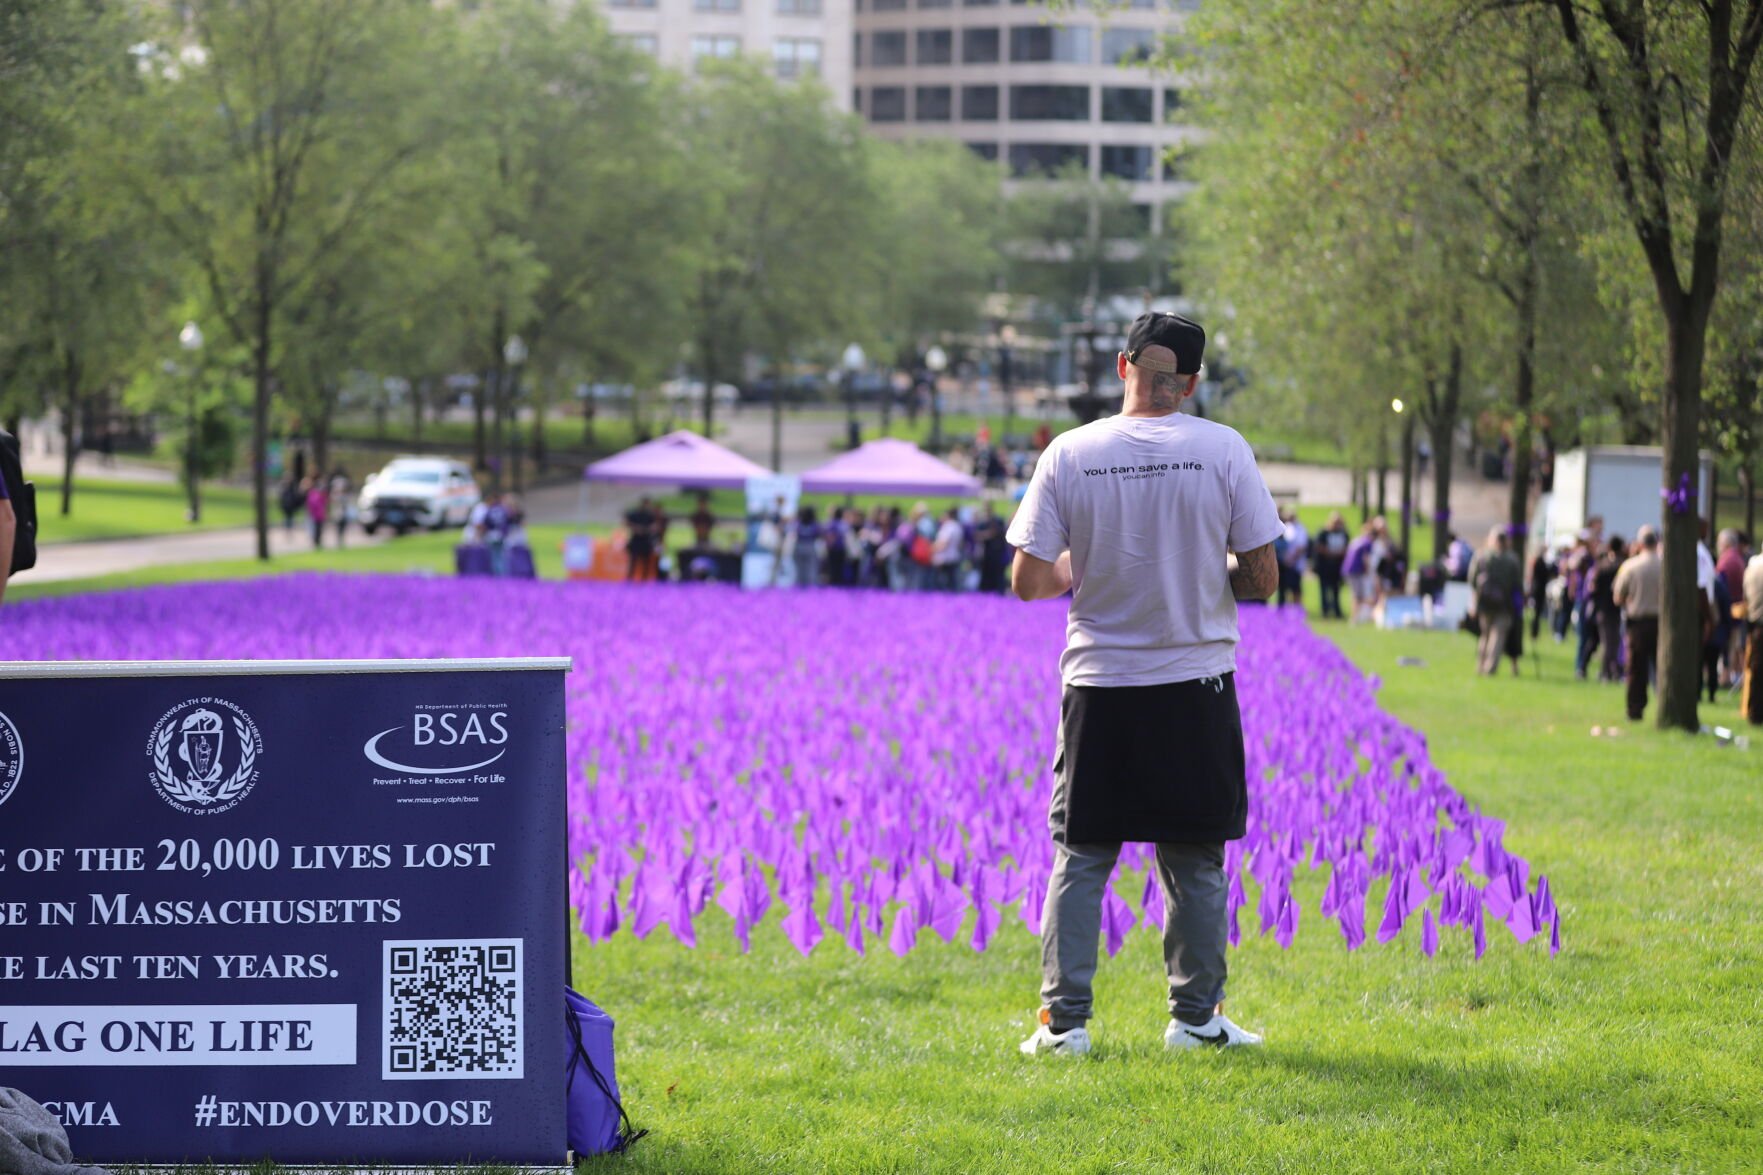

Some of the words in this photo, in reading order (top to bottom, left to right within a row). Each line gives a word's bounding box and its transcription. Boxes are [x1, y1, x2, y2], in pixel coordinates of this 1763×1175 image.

[1084, 467, 1107, 477] You
[1110, 466, 1135, 474] can
[1138, 463, 1168, 473] save
[1171, 463, 1180, 471] a
[1183, 461, 1205, 471] life.
[3, 728, 18, 755] NOBIS
[146, 697, 199, 756] COMMONWEALTH
[213, 697, 263, 754] MASSACHUSETTS
[414, 712, 508, 746] BSAS
[7, 760, 18, 778] 1822
[373, 777, 402, 786] Prevent
[409, 777, 427, 785] Treat
[434, 777, 466, 785] Recover
[474, 775, 488, 784] For
[490, 774, 506, 783] Life
[148, 771, 193, 814] DEPARTMENT
[194, 808, 206, 816] OF
[207, 799, 239, 815] PUBLIC
[237, 770, 260, 802] HEALTH
[397, 795, 479, 805] www.mass.gov/dph/bsas
[17, 848, 65, 872] OF
[75, 848, 145, 871] THE
[156, 838, 280, 878] 20,000
[291, 844, 391, 870] LIVES
[403, 842, 496, 868] LOST
[38, 902, 77, 926] IN
[87, 893, 402, 925] MASSACHUSETTS
[35, 956, 122, 980] LAST
[133, 955, 202, 979] TEN
[213, 953, 339, 979] YEARS.
[100, 1020, 194, 1052] ONE
[209, 1020, 313, 1052] LIFE
[194, 1095, 493, 1127] #ENDOVERDOSE
